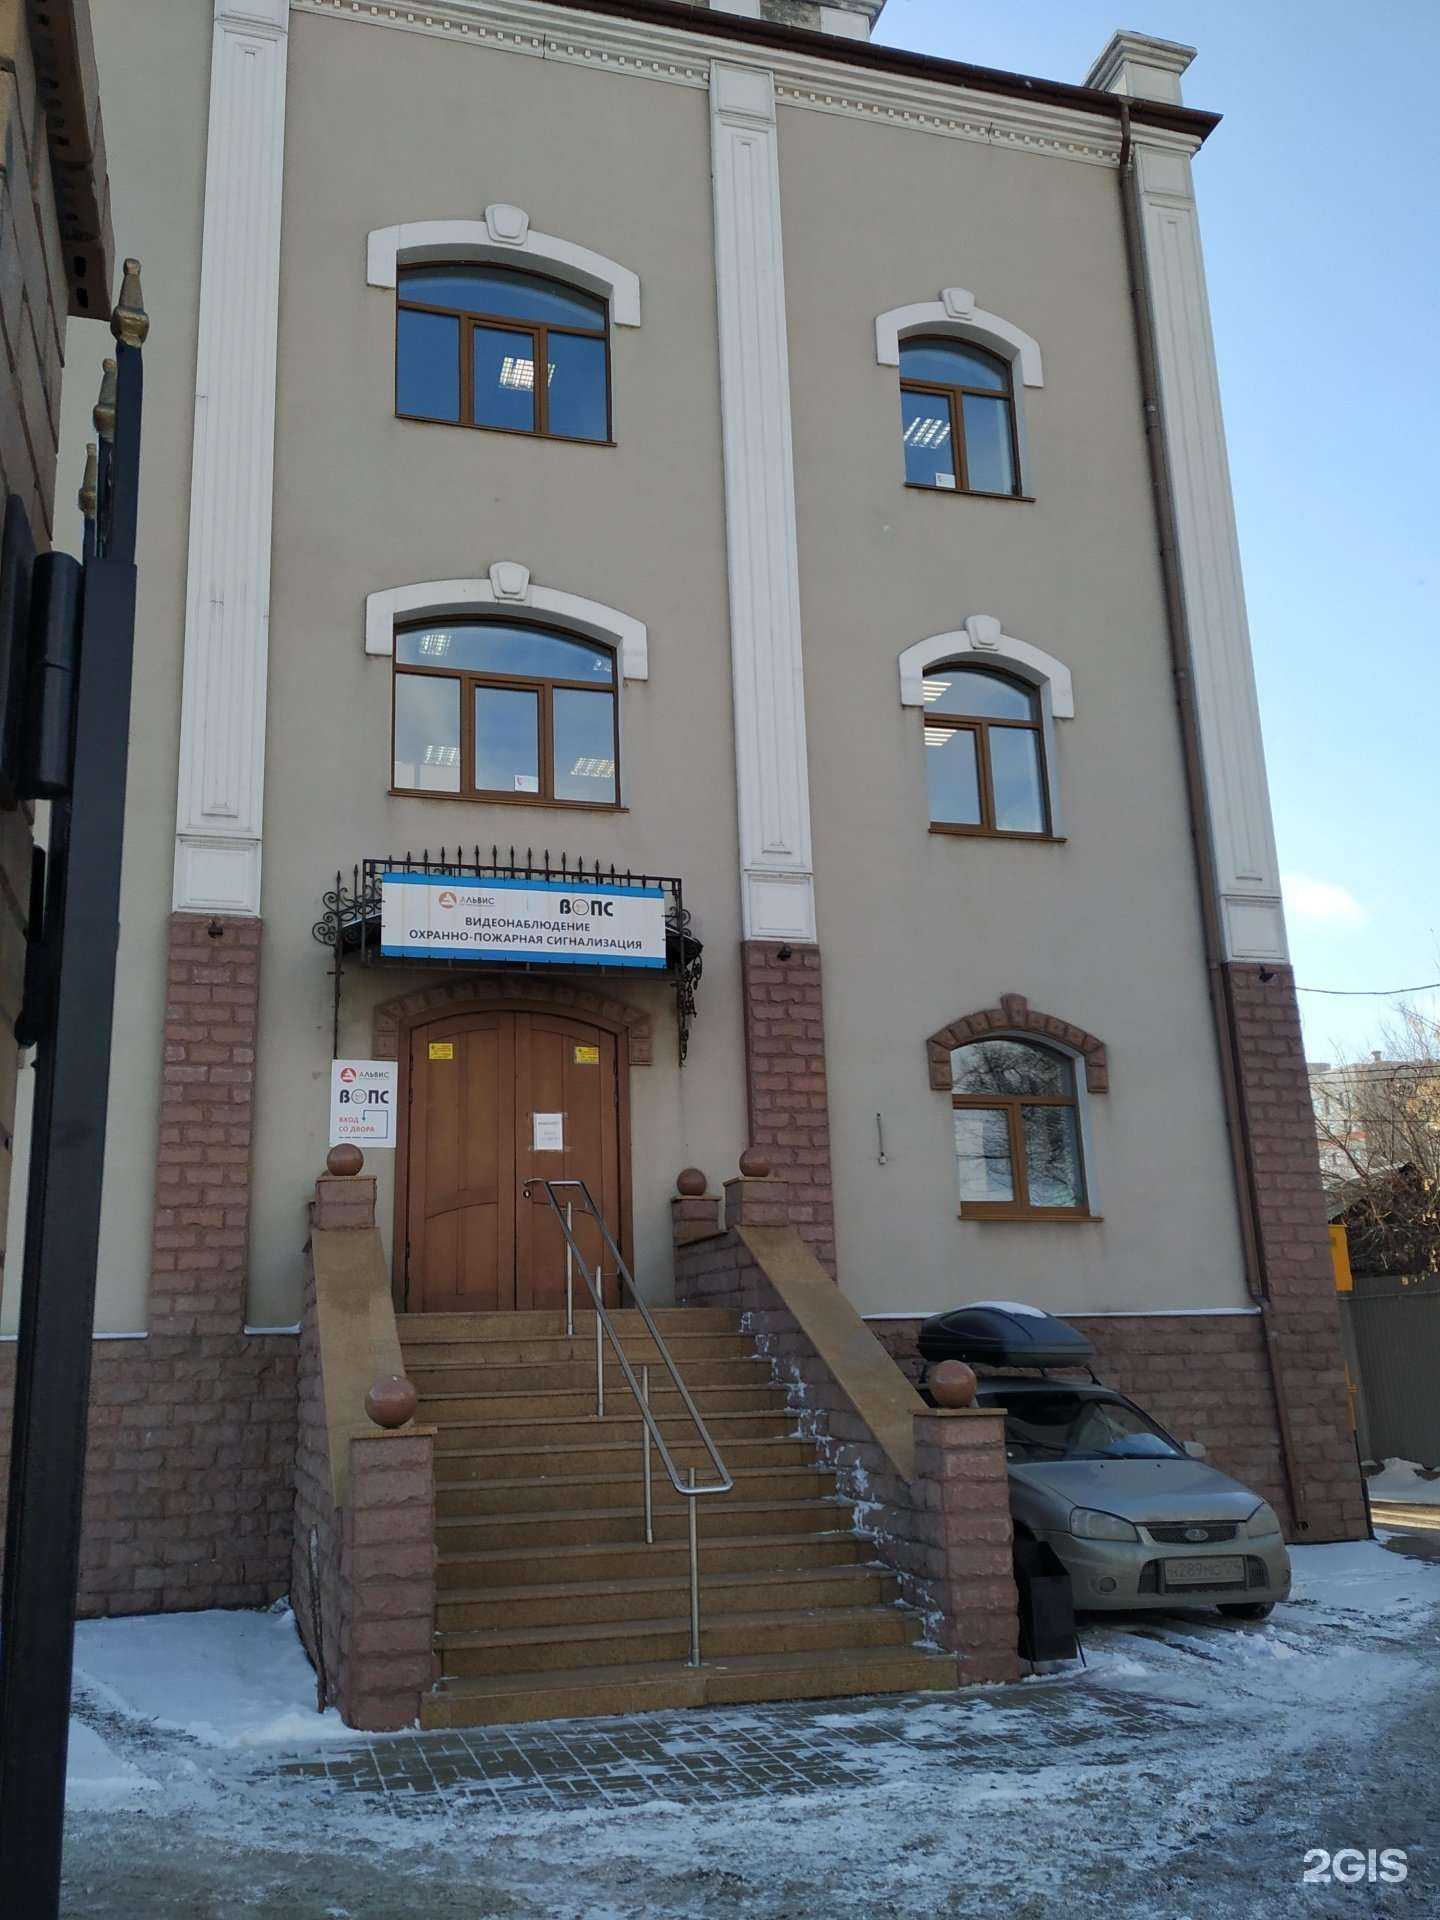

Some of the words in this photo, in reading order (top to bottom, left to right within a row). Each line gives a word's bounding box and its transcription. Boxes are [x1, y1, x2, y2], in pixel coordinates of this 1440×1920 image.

[465, 916, 590, 932] ВИДЕОНАБЛЮДЕНИЕ
[409, 929, 544, 945] ОХРАННО-ПОЖАРНАЯ
[546, 935, 642, 950] СИГНАЛИЗАЦИЯ
